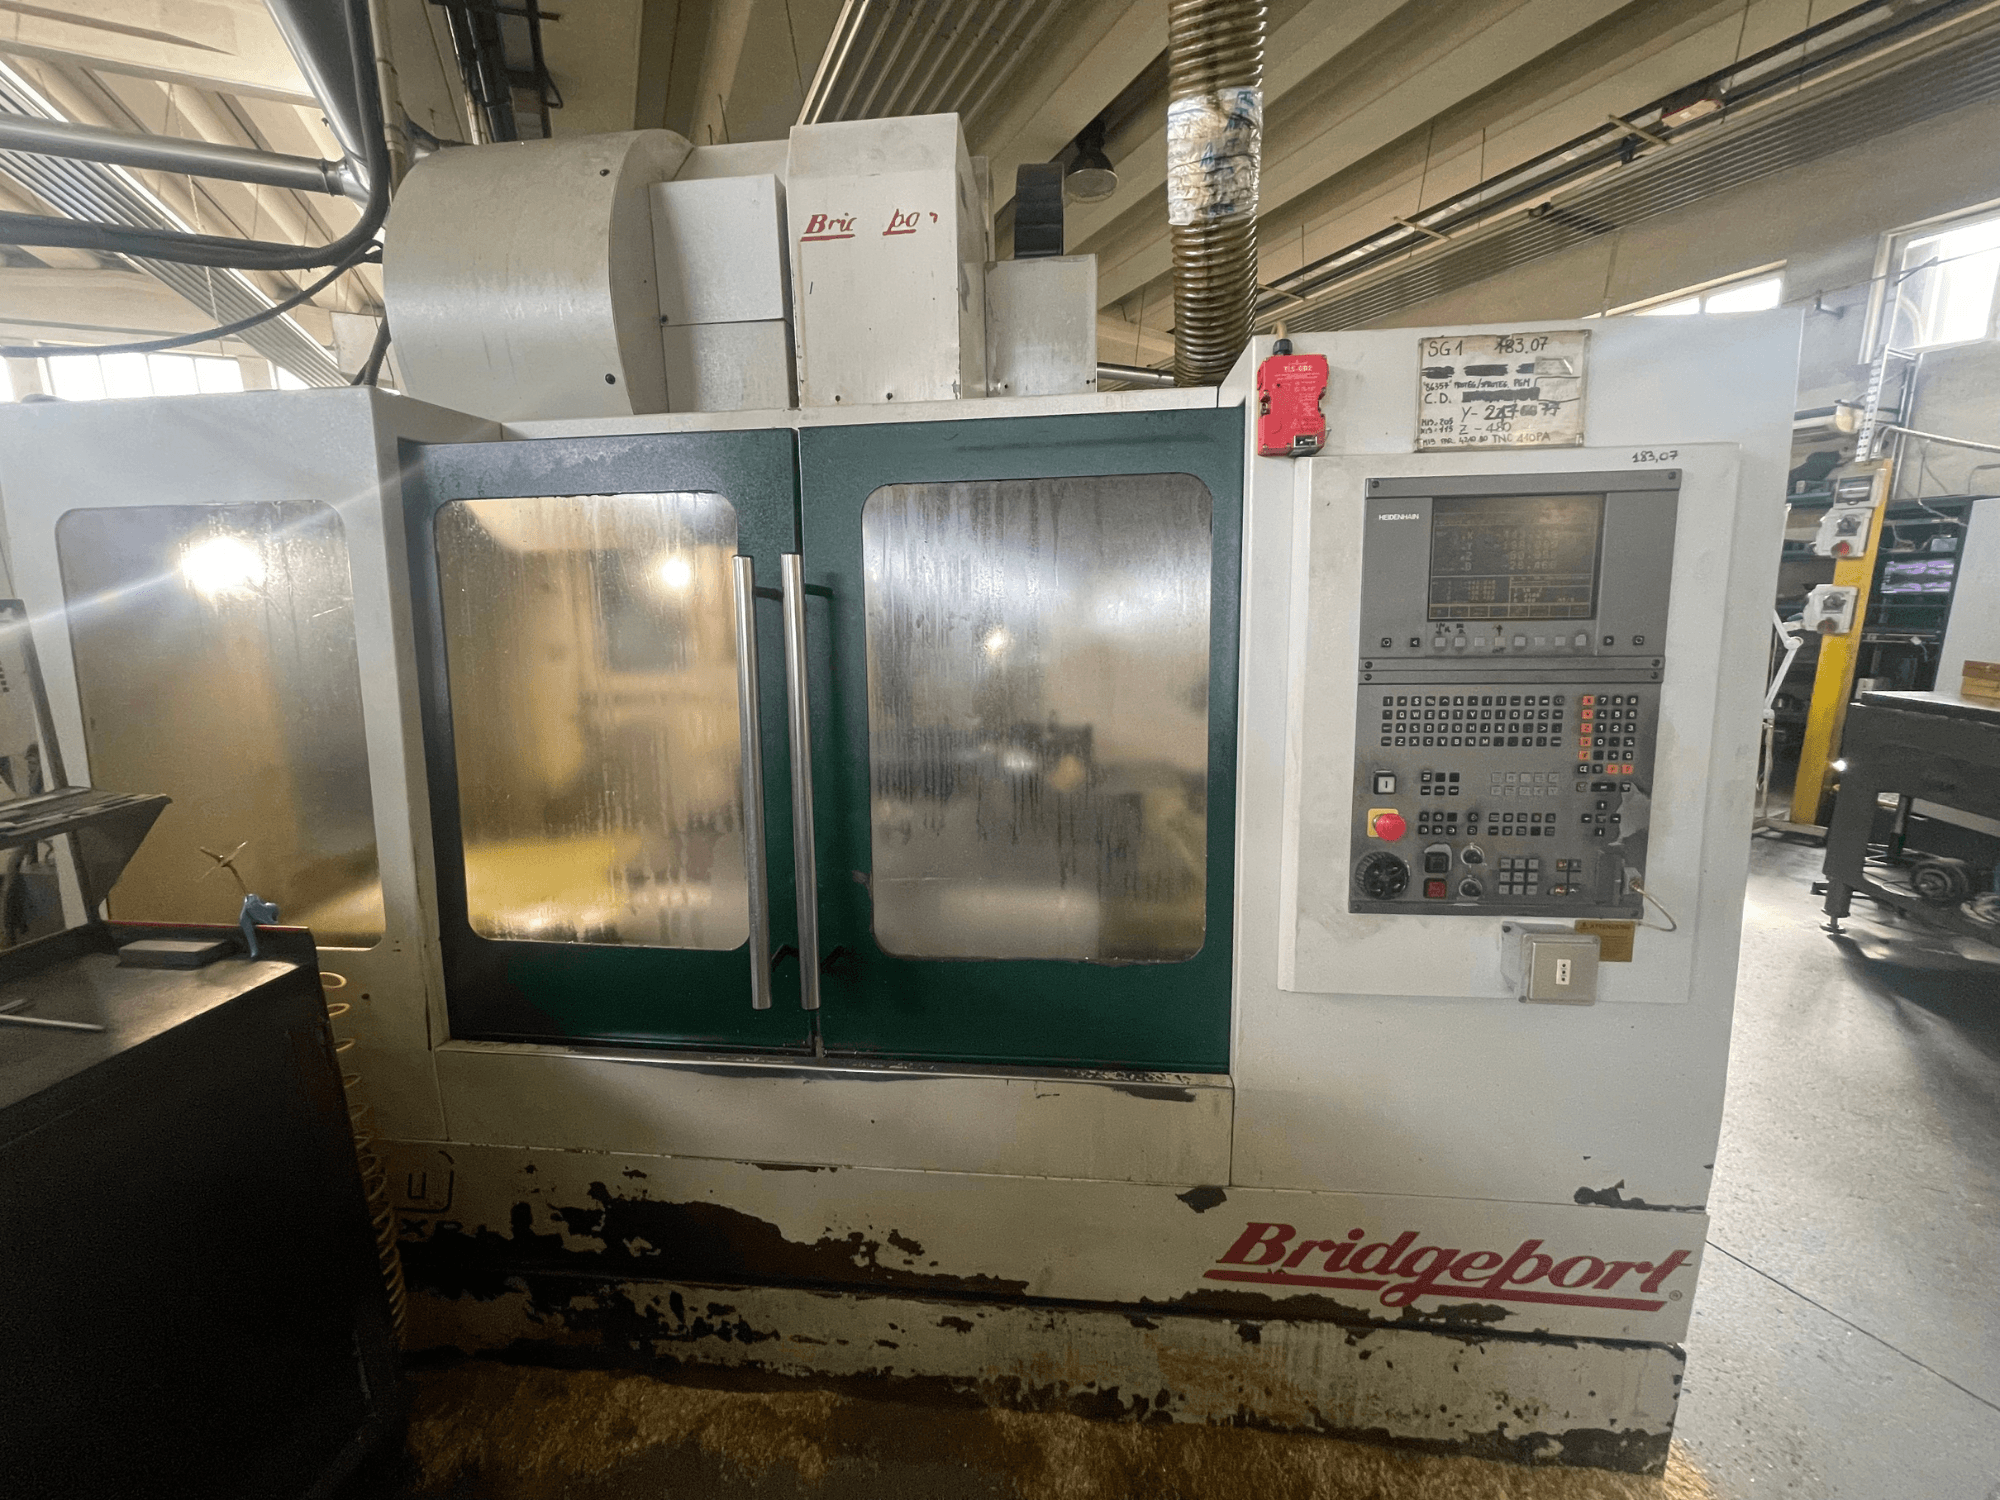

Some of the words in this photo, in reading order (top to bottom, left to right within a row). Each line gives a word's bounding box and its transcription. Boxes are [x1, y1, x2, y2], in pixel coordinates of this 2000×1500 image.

[1424, 392, 1452, 404] C.D.
[1631, 450, 1679, 463] 183,07
[1378, 513, 1420, 521] HEIDENHAIN
[1204, 1222, 1693, 1311] Bridgeport
